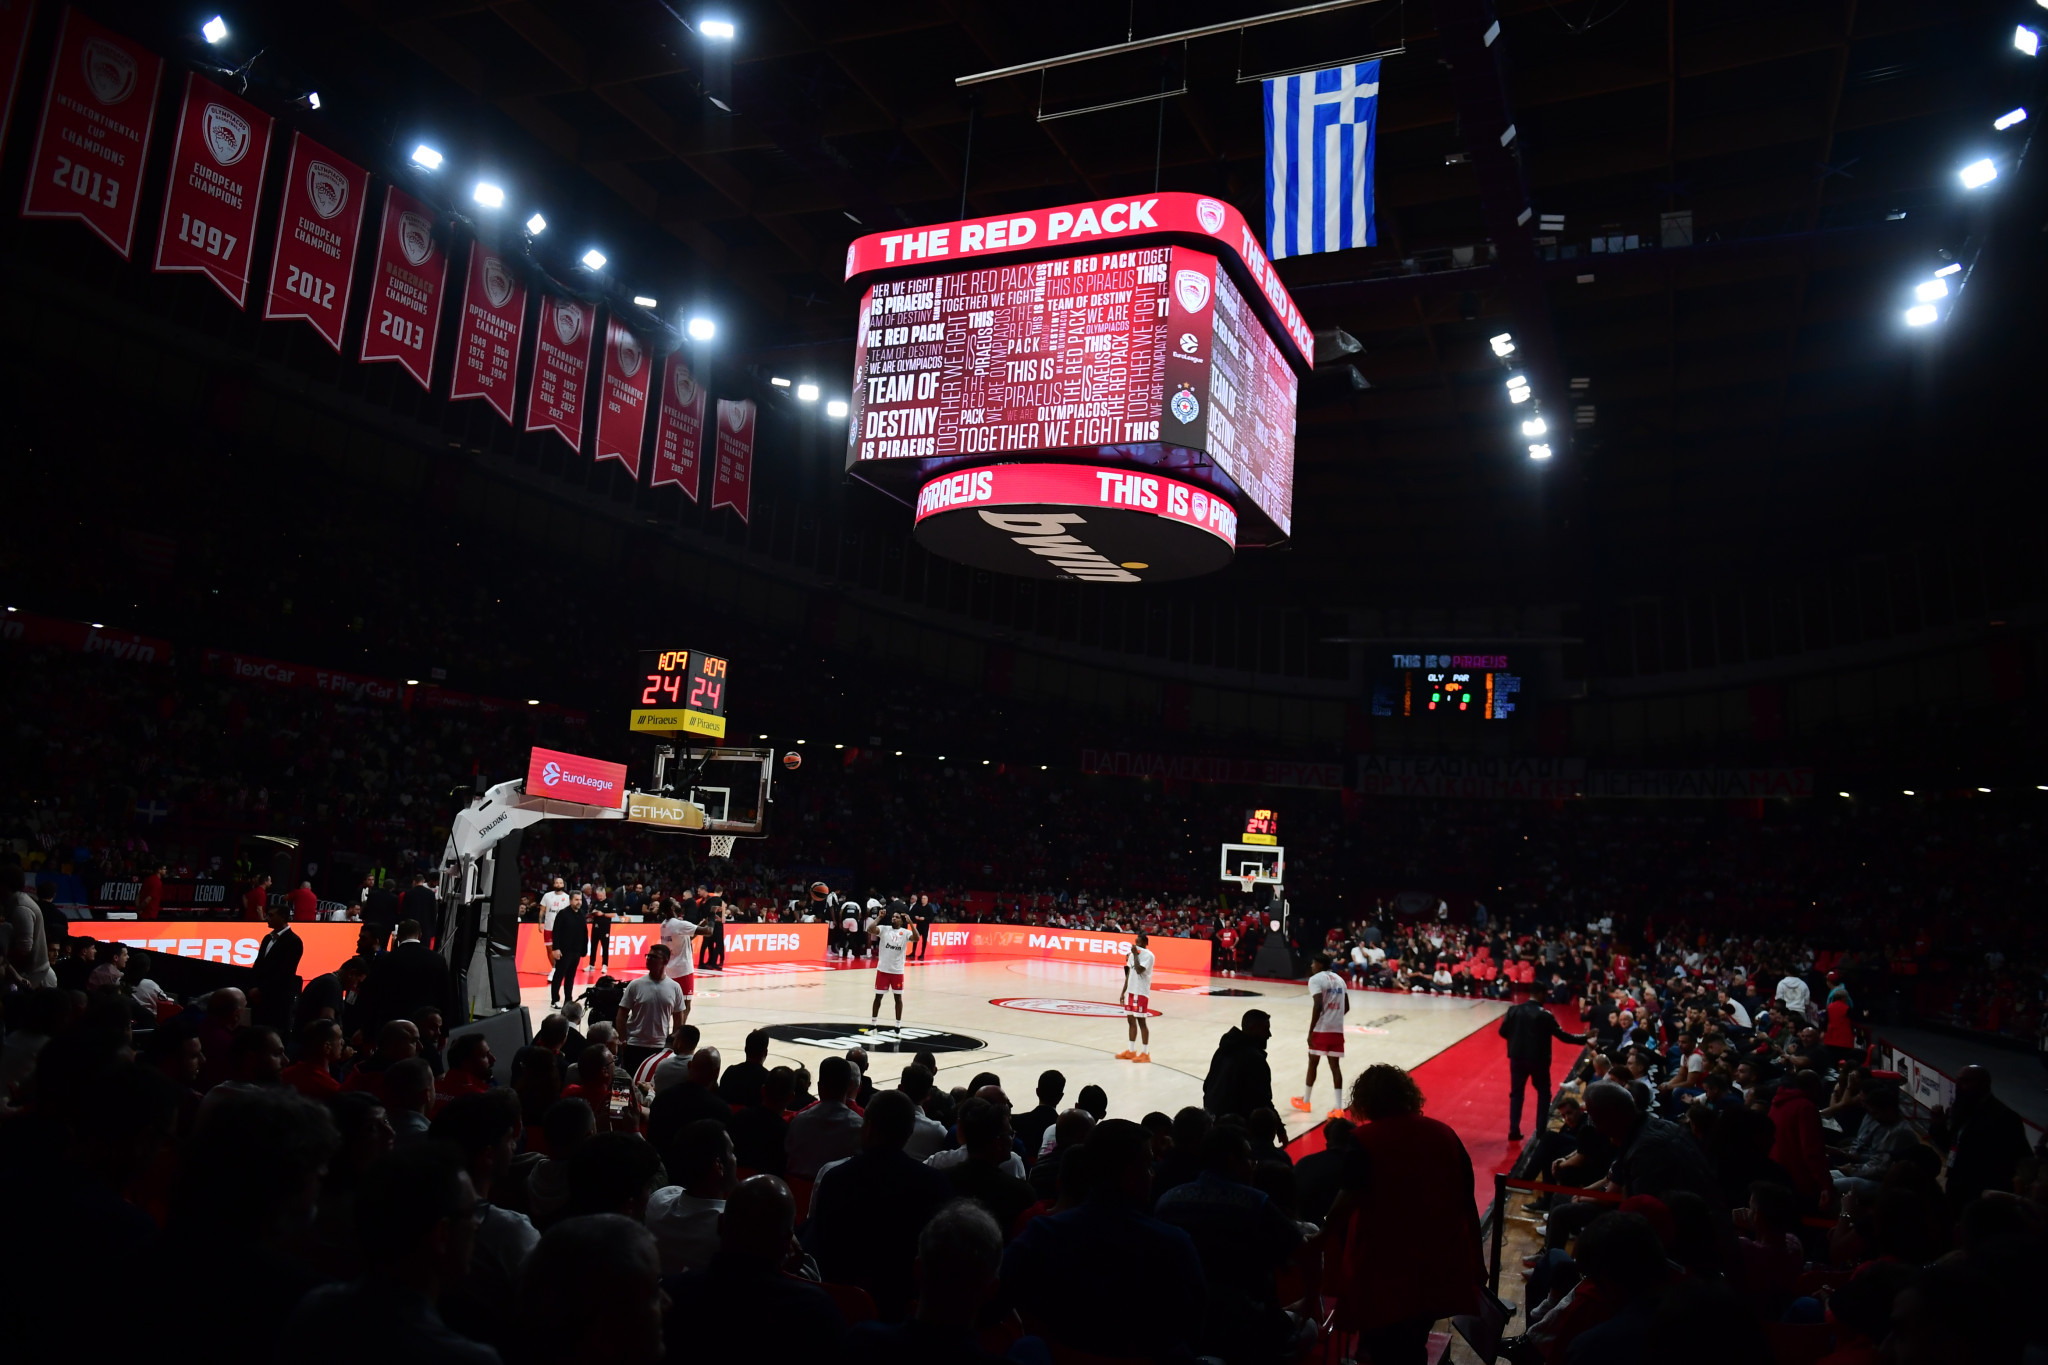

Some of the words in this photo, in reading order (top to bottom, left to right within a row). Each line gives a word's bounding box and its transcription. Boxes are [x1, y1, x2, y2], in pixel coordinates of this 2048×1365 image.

[57, 92, 140, 143] INTERCONTINENTAL
[211, 107, 247, 131] OLYMPIACOS
[87, 124, 106, 139] CUP
[61, 126, 126, 167] CHAMPIONS
[52, 154, 120, 209] 2013
[193, 161, 243, 197] EUROPEAN
[314, 164, 345, 185] OLYMPIACOS
[189, 174, 243, 210] CHAMPIONS
[178, 212, 238, 261] 1997
[299, 216, 342, 247] EUROPEAN
[880, 231, 949, 262] THE
[960, 215, 1037, 252] RED
[1047, 198, 1159, 241] PACK
[294, 227, 341, 260] CHAMPIONS
[1047, 261, 1069, 277] THE
[1074, 257, 1098, 274] RED
[1102, 252, 1137, 271] PACK
[1136, 263, 1167, 284] THIS
[286, 264, 336, 310] 2012
[389, 276, 428, 304] EUROPEAN
[873, 283, 889, 298] HER
[892, 281, 906, 295] WE
[908, 278, 934, 293] FIGHT
[944, 274, 968, 297] THE
[971, 270, 997, 294] RED
[1001, 265, 1036, 290] PACK
[1047, 277, 1071, 297] THIS
[1073, 275, 1084, 294] IS
[1086, 269, 1135, 292] PIRAEUS
[386, 287, 428, 316] CHAMPIONS
[871, 298, 882, 315] IS
[885, 292, 934, 313] PIRAEUS
[942, 295, 988, 312] TOGETHER
[991, 293, 1005, 307] WE
[1008, 289, 1036, 305] FIGHT
[1048, 297, 1074, 312] TEAM
[1076, 295, 1089, 309] OF
[1090, 290, 1133, 307] DESTINY
[1134, 286, 1156, 323] FIGHT
[1242, 225, 1265, 285] THE
[1265, 266, 1287, 317] RED
[1287, 304, 1314, 363] PACK
[885, 314, 895, 326] OF
[897, 310, 932, 324] DESTINY
[969, 310, 994, 328] THIS
[1011, 305, 1033, 321] THE
[1087, 308, 1104, 324] WE
[1107, 305, 1129, 322] ARE
[380, 309, 425, 351] 2013
[476, 318, 509, 342] ΕΛΛΑΔΑΣ
[868, 330, 882, 348] HE
[885, 327, 908, 346] RED
[911, 323, 945, 343] PACK
[945, 315, 968, 354] FIGHT
[1009, 321, 1032, 338] RED
[1068, 308, 1087, 344] PACK
[1085, 320, 1130, 335] OLYMPIACOS
[1132, 324, 1154, 348] WE
[872, 348, 893, 360] TEAM
[896, 347, 906, 359] OF
[908, 343, 943, 358] DESTINY
[974, 328, 993, 376] PIRAEUS
[989, 308, 1011, 377] OLYMPIACOS
[1008, 336, 1040, 354] PACK
[1084, 334, 1112, 353] THIS
[1111, 333, 1130, 365] PACK
[870, 362, 881, 374] WE
[882, 360, 895, 373] ARE
[897, 356, 942, 372] OLYMPIACOS
[943, 355, 965, 380] WE
[1065, 348, 1084, 375] RED
[1172, 351, 1204, 364] EuroLeague
[1007, 359, 1037, 383] THIS
[1040, 358, 1054, 380] IS
[1092, 351, 1112, 402] PIRAEUS
[1109, 367, 1127, 391] RED
[868, 374, 915, 404] TEAM
[917, 372, 940, 400] OF
[964, 376, 985, 392] THE
[988, 381, 1005, 401] ARE
[1004, 382, 1062, 408] PIRAEUS
[1063, 378, 1081, 404] THE
[1127, 349, 1152, 420] TOGETHER
[1211, 364, 1229, 409] TEAM
[1228, 387, 1236, 418] OF
[962, 392, 985, 408] RED
[1038, 402, 1108, 421] OLYMPIACOS
[1107, 393, 1125, 417] THE
[866, 407, 939, 439] DESTINY
[936, 381, 962, 455] TOGETHER
[960, 408, 985, 425] PACK
[986, 406, 1003, 423] WE
[959, 423, 1039, 453] TOGETHER
[1045, 421, 1070, 447] WE
[1074, 417, 1123, 445] FIGHT
[1124, 421, 1159, 442] THIS
[1209, 402, 1236, 454] DESTINY
[861, 441, 874, 459] IS
[878, 437, 935, 458] PIRAEUS
[921, 470, 993, 515] PiRAEUS
[1096, 471, 1158, 509] THIS
[1167, 483, 1189, 517] IS
[978, 509, 1149, 583] bwin
[82, 630, 156, 664] bwin
[658, 651, 688, 671] 1:09
[703, 657, 727, 679] 1:09
[1392, 654, 1421, 669] THIS
[1424, 654, 1439, 669] IS
[1427, 674, 1445, 682] OLY
[642, 675, 681, 704] 24
[690, 676, 721, 709] 24
[647, 715, 678, 725] Piraeus
[697, 717, 720, 732] Piraeus
[562, 771, 613, 791] EuroLeague
[1748, 766, 1815, 796] ΜΑΣ
[479, 811, 508, 839] SPALDING
[629, 805, 685, 821] ETIHAD
[1247, 818, 1269, 834] 24
[100, 881, 115, 901] WE
[115, 882, 143, 900] FIGHT
[194, 884, 225, 902] LEGEND
[885, 942, 902, 951] bwin
[931, 931, 970, 946] EVERY
[971, 932, 1024, 945] GAME
[1029, 934, 1133, 955] MATTERS
